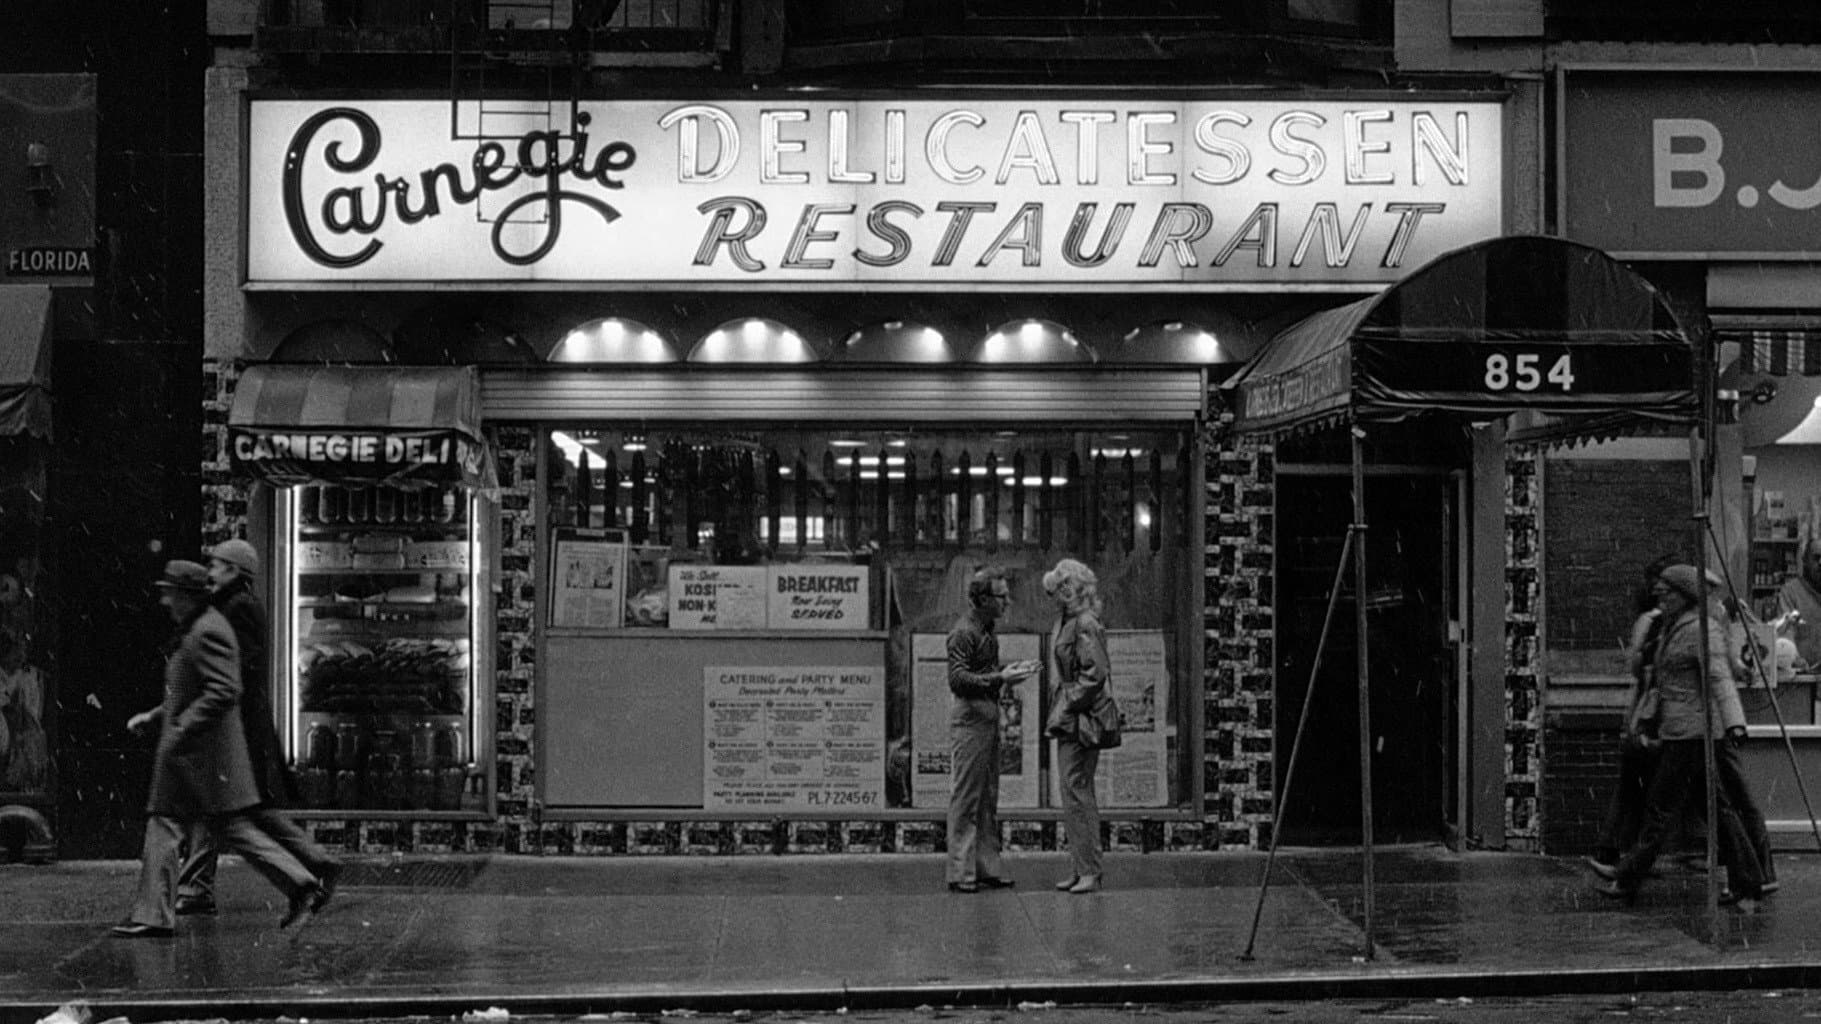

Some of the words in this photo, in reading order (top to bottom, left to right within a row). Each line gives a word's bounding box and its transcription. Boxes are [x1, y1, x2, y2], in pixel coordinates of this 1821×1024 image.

[282, 107, 637, 269] Carnegie
[658, 104, 1469, 186] DELICATESSEN
[691, 196, 1446, 272] RESTAURANT
[10, 250, 90, 271] FLORIDA
[1484, 354, 1575, 391] 854
[235, 435, 378, 462] CARNEGIE
[385, 437, 450, 464] DELI
[777, 576, 860, 594] BREAKFAST
[791, 609, 844, 620] SERVED
[720, 674, 775, 685] CATERING
[778, 676, 799, 685] and
[801, 674, 835, 685] PARTY
[840, 674, 872, 685] MENU
